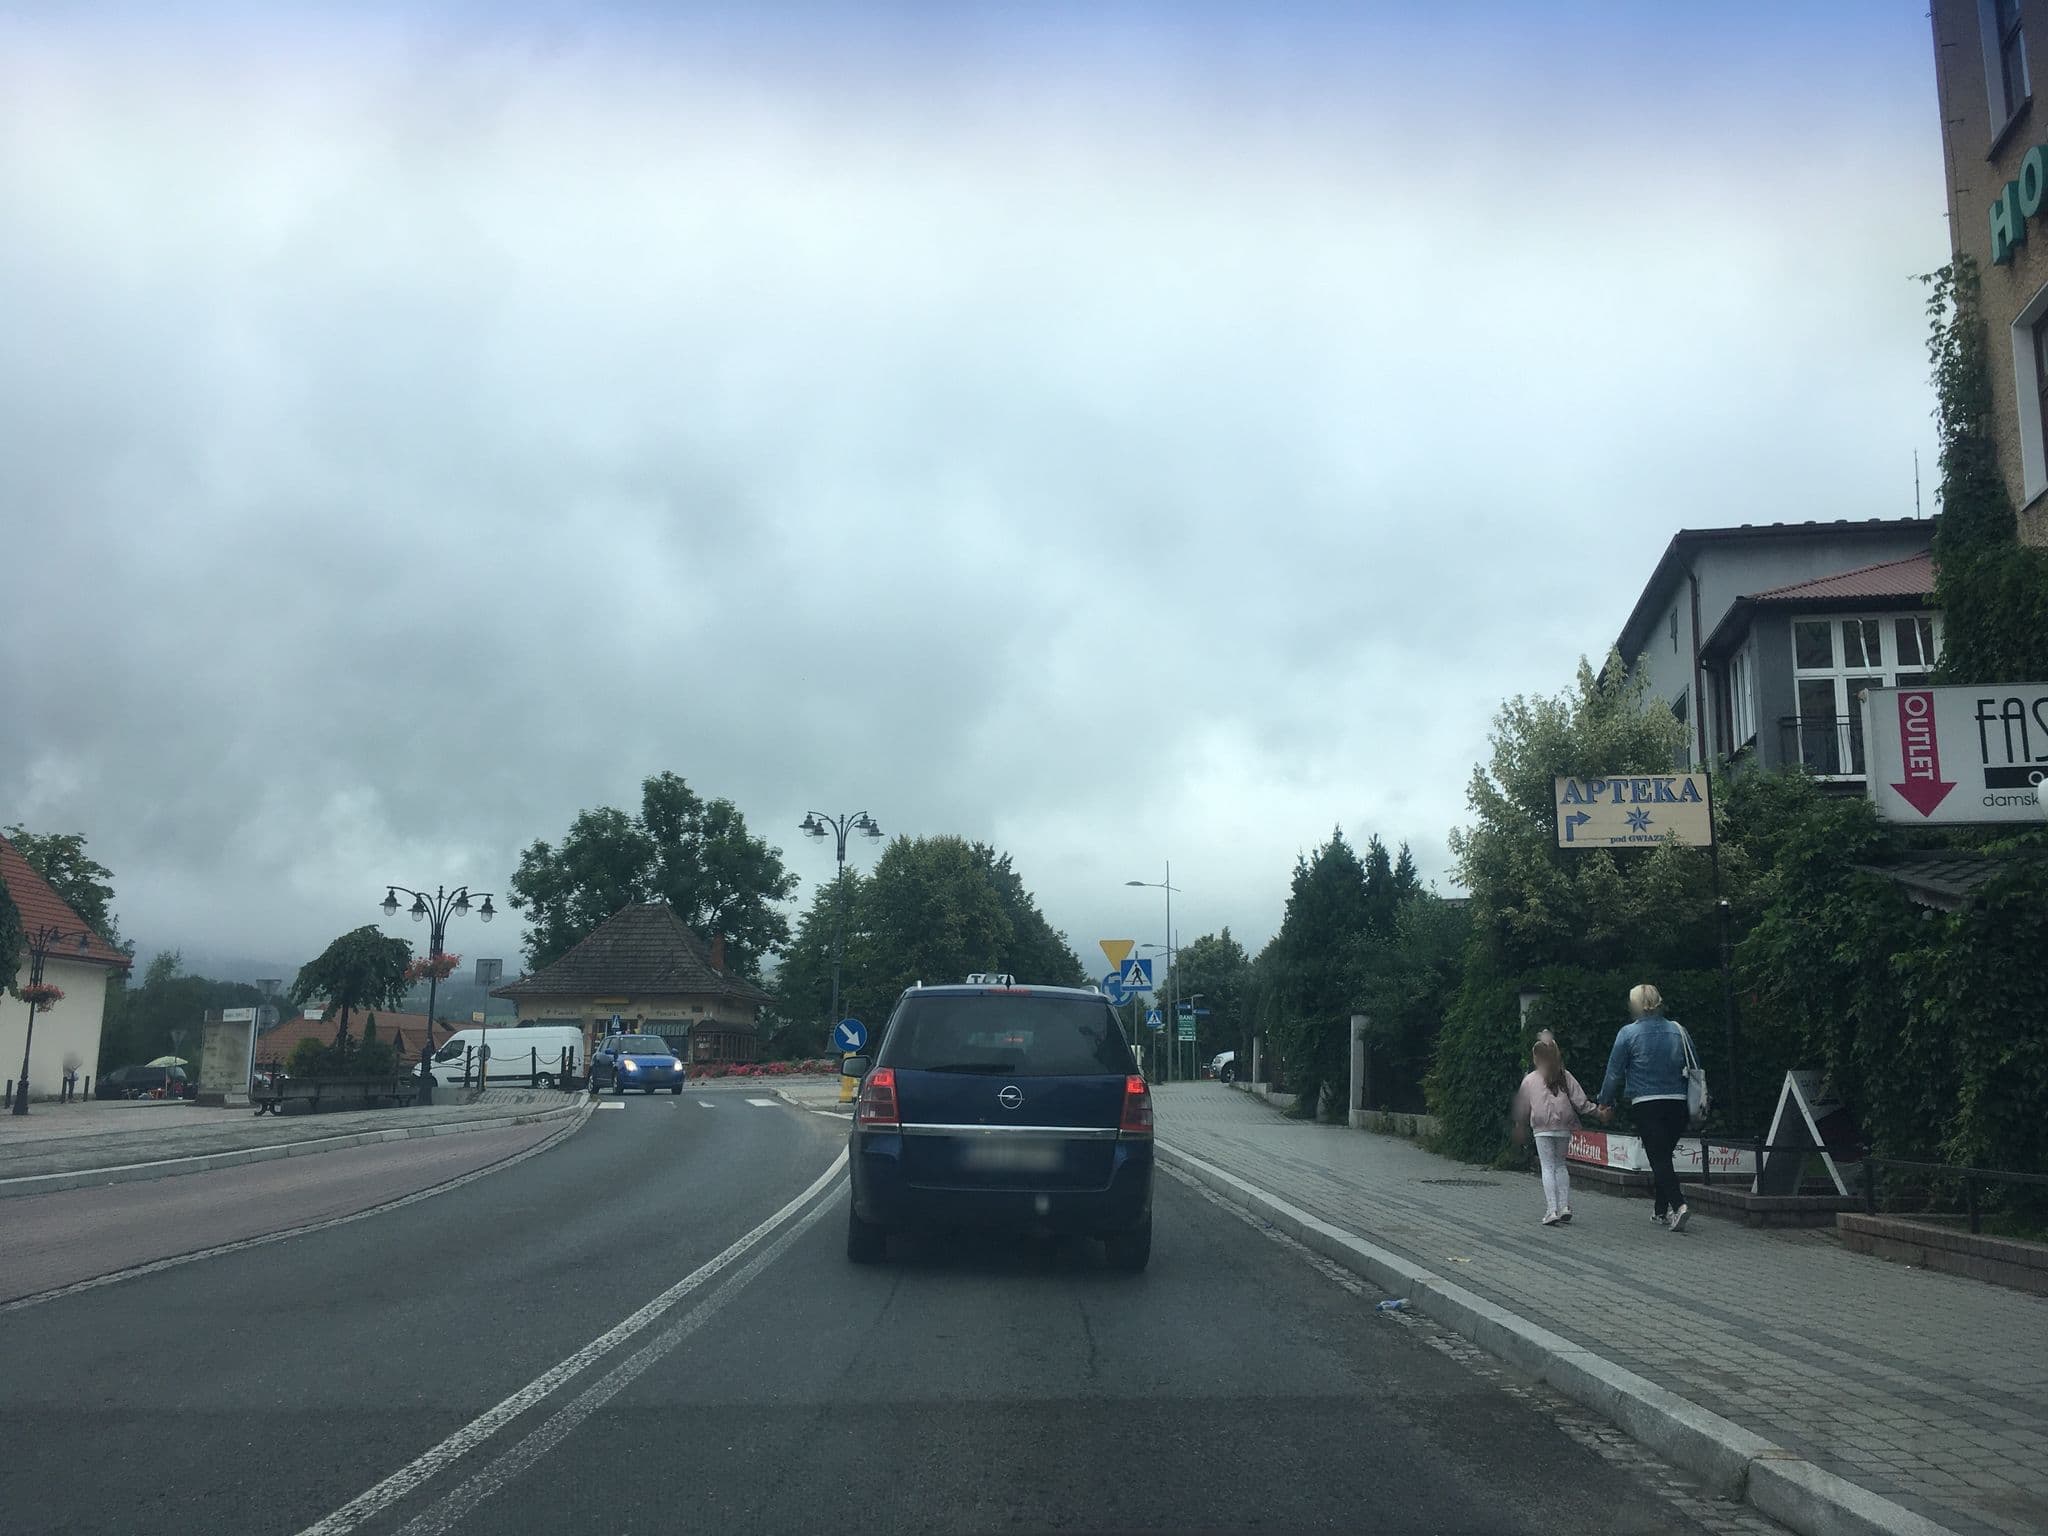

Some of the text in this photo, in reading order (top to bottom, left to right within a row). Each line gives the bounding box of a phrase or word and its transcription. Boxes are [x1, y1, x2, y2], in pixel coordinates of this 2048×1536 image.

[1905, 695, 1934, 781] OUTLET
[1560, 777, 1703, 804] APTEKA
[1690, 1150, 1741, 1172] Trumph
